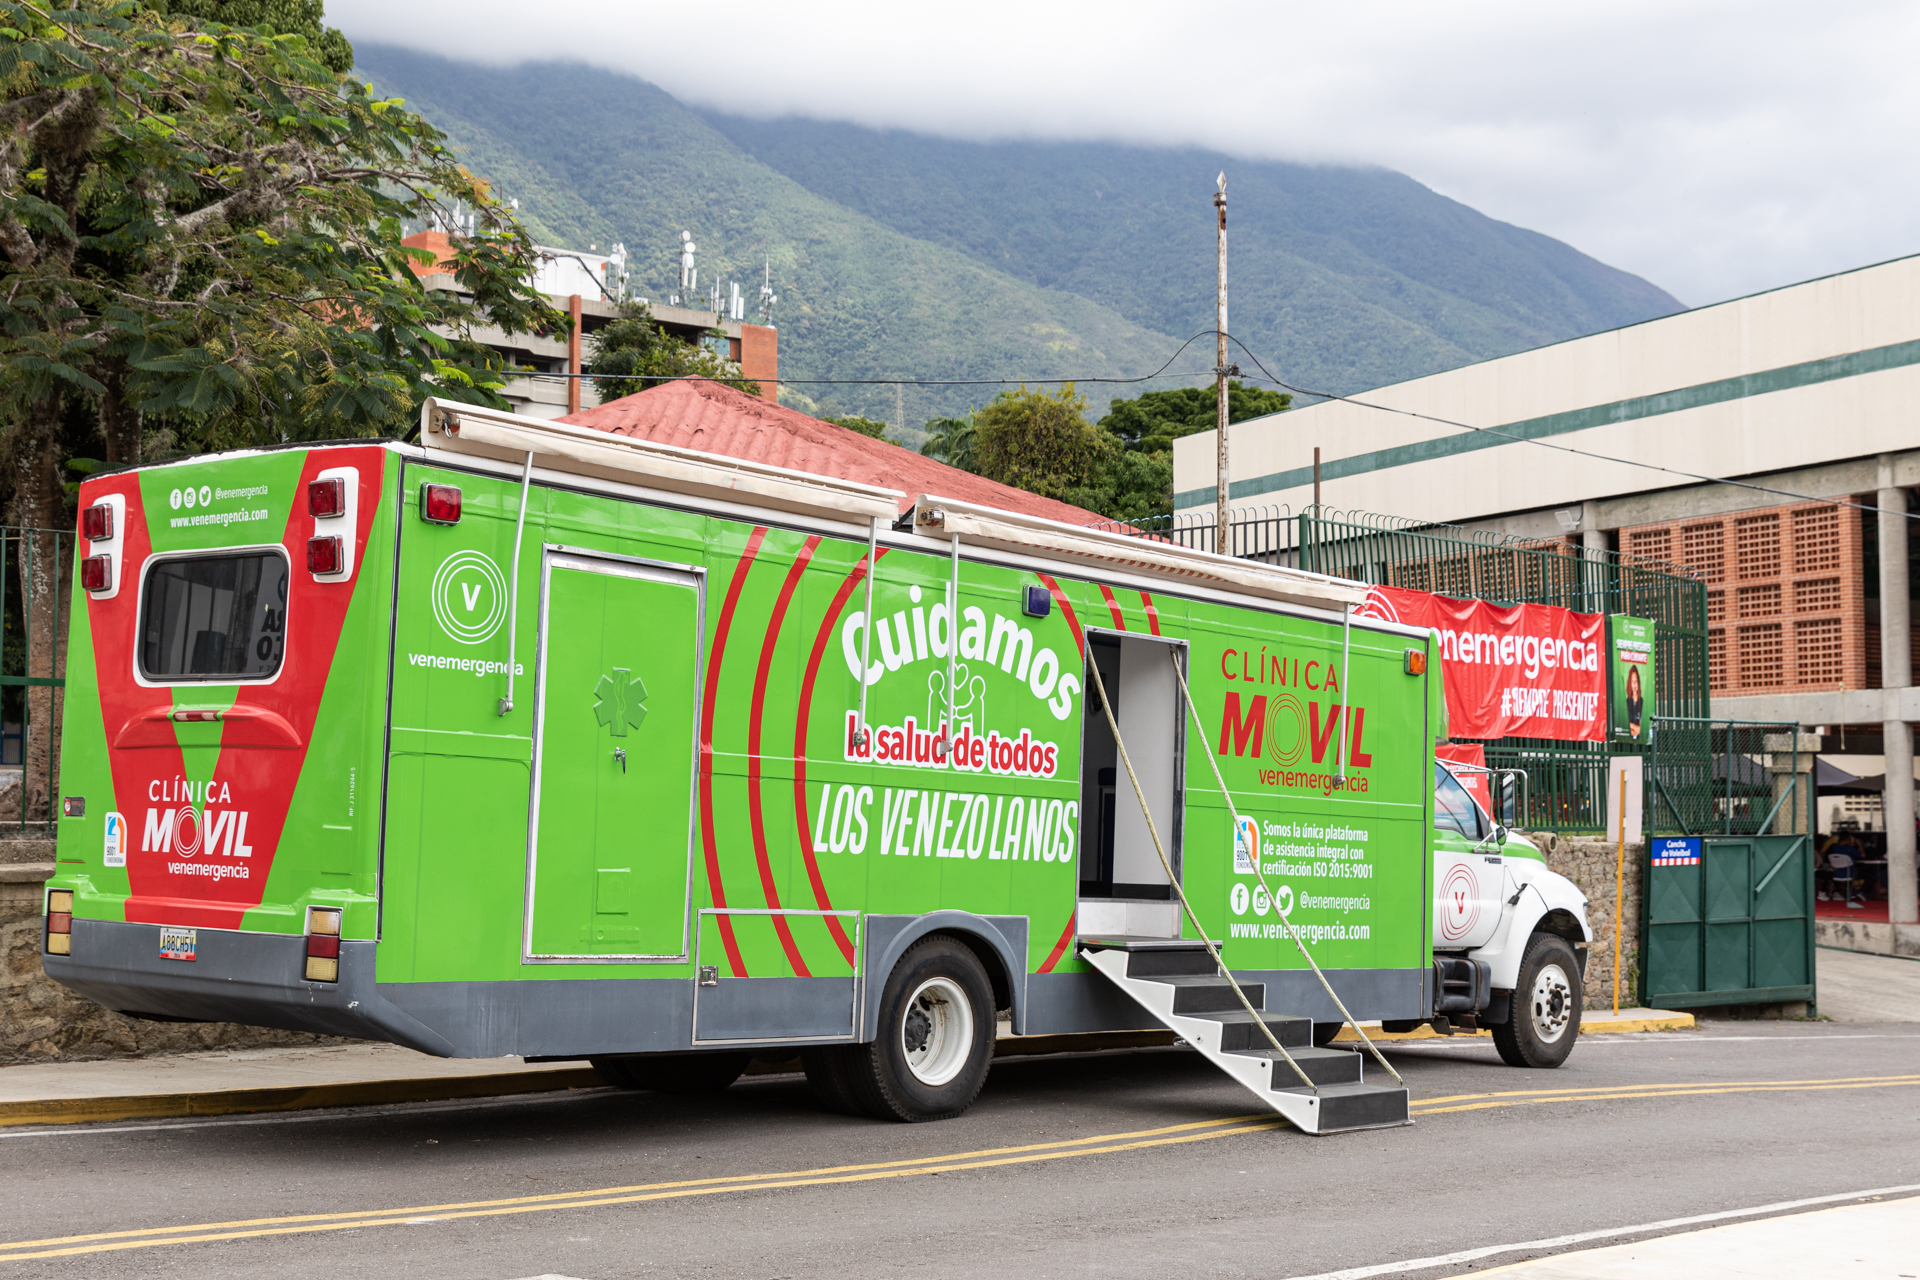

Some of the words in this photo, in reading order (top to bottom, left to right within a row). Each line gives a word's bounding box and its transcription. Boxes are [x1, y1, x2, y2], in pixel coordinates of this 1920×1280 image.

[215, 485, 268, 500] @venemergencia
[170, 508, 268, 528] www.venemergencia.com
[842, 582, 1081, 721] Cuidamos
[1430, 626, 1598, 679] nemergencia
[1221, 646, 1339, 693] CLÍNICA
[1218, 691, 1372, 768] MOVIL
[847, 713, 872, 760] la
[875, 718, 948, 766] salud
[952, 725, 985, 770] de
[988, 731, 1057, 776] todos
[149, 775, 231, 803] CLÍNICA
[142, 805, 252, 858] MOVIL
[814, 784, 873, 854] LOS
[880, 788, 1078, 863] VENEZOLANOS
[1263, 820, 1291, 837] Somos
[1293, 821, 1301, 838] la
[1302, 822, 1324, 839] única
[1325, 824, 1368, 843] plataforma
[1263, 839, 1274, 855] de
[1275, 841, 1315, 858] asistencia
[1317, 842, 1348, 863] integral
[1350, 848, 1364, 860] con
[168, 862, 249, 881] venemergencia
[1263, 859, 1311, 876] certificación
[1313, 862, 1327, 877] ISO
[1329, 862, 1373, 879] 2015:9001
[1300, 891, 1370, 914] @venemergencia
[1230, 920, 1370, 945] www.venemergencia.com
